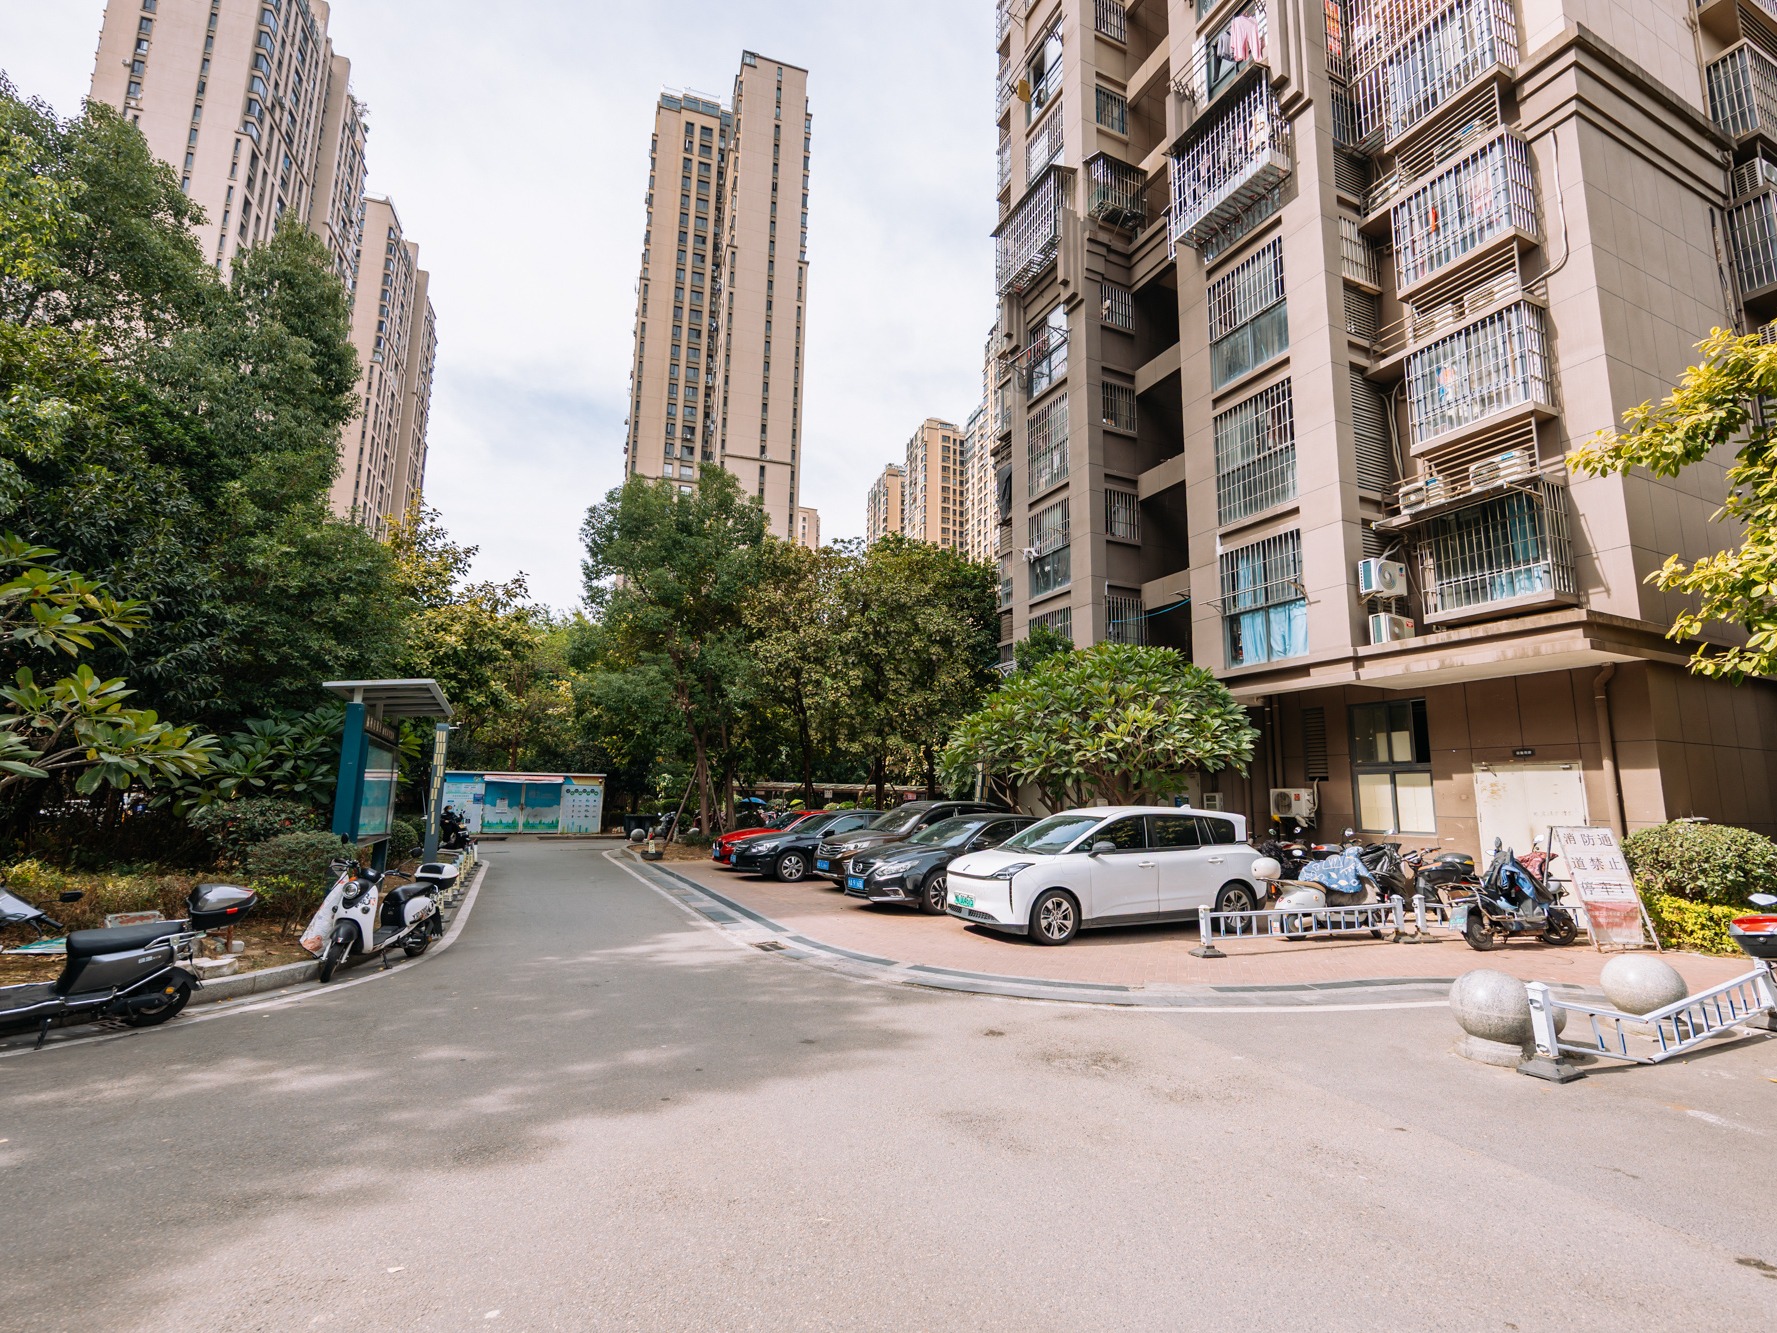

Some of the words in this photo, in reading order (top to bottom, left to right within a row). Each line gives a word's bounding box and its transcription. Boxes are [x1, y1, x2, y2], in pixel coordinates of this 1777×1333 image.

[1563, 832, 1613, 847] 消防通
[1571, 856, 1623, 871] 道禁止
